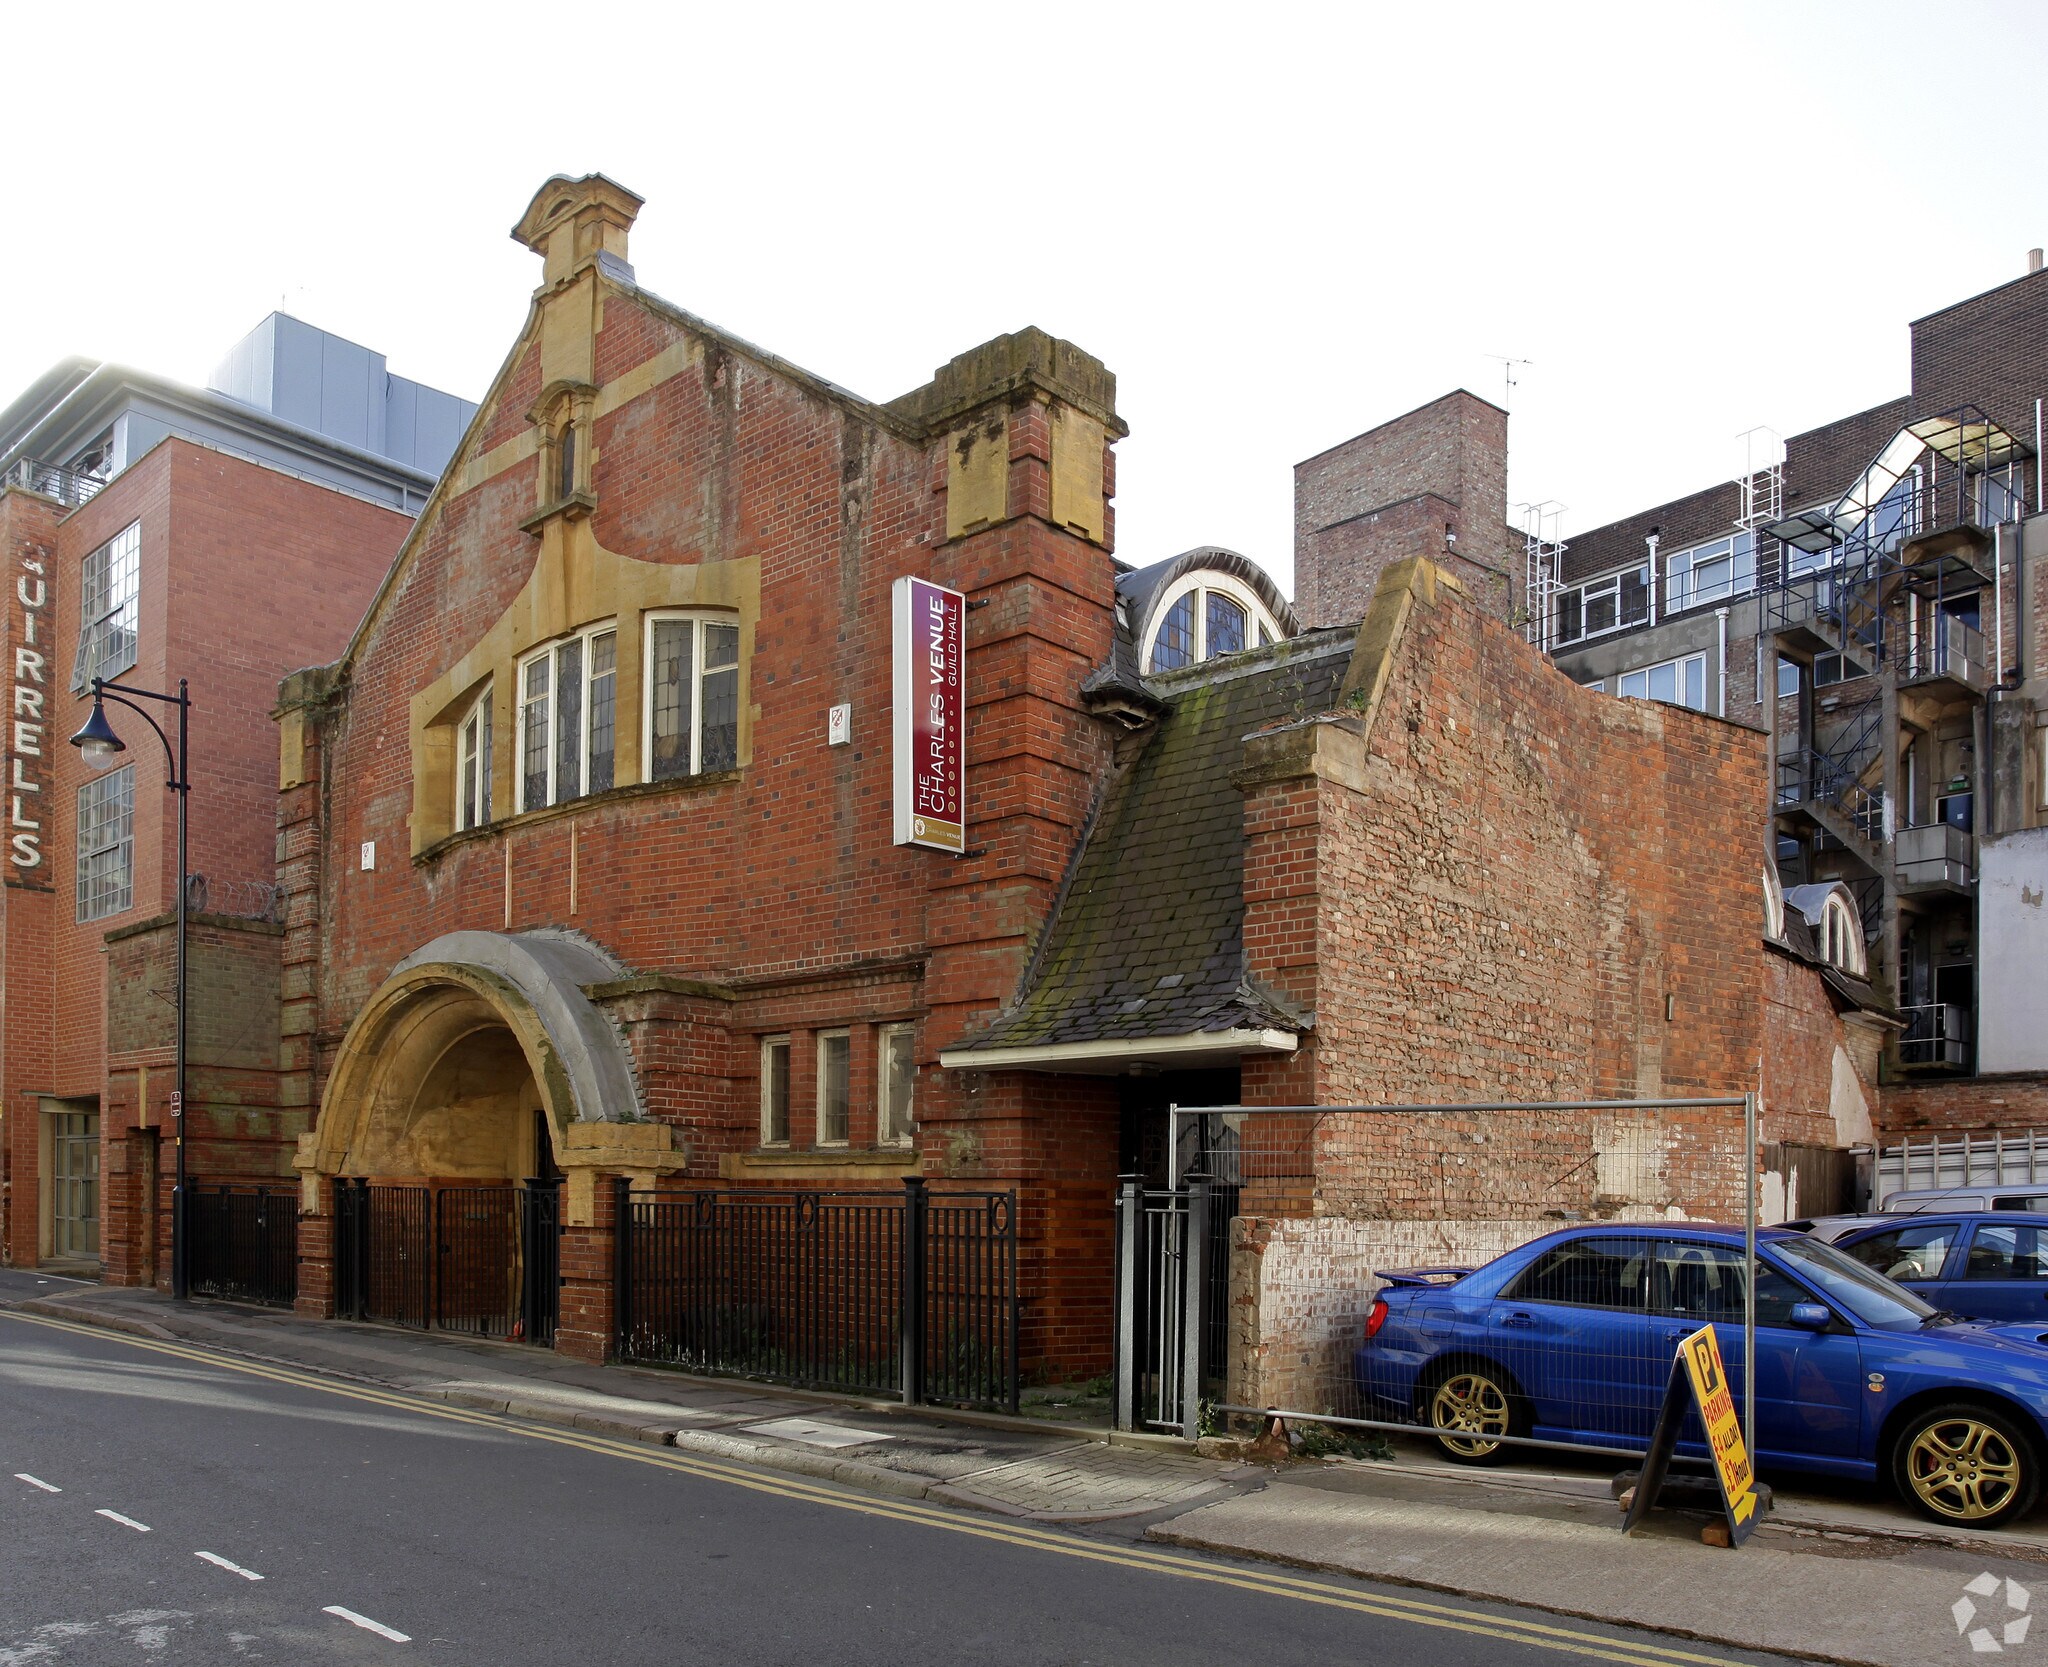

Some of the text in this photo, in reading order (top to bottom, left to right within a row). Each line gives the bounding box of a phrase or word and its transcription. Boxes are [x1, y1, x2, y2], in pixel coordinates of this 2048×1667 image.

[948, 604, 957, 687] GUILD HALL
[929, 595, 945, 813] CHARLES VENUE
[919, 773, 929, 810] THE
[1696, 1343, 1711, 1389] P
[1703, 1387, 1732, 1429] PARKING
[1712, 1433, 1724, 1463] £4
